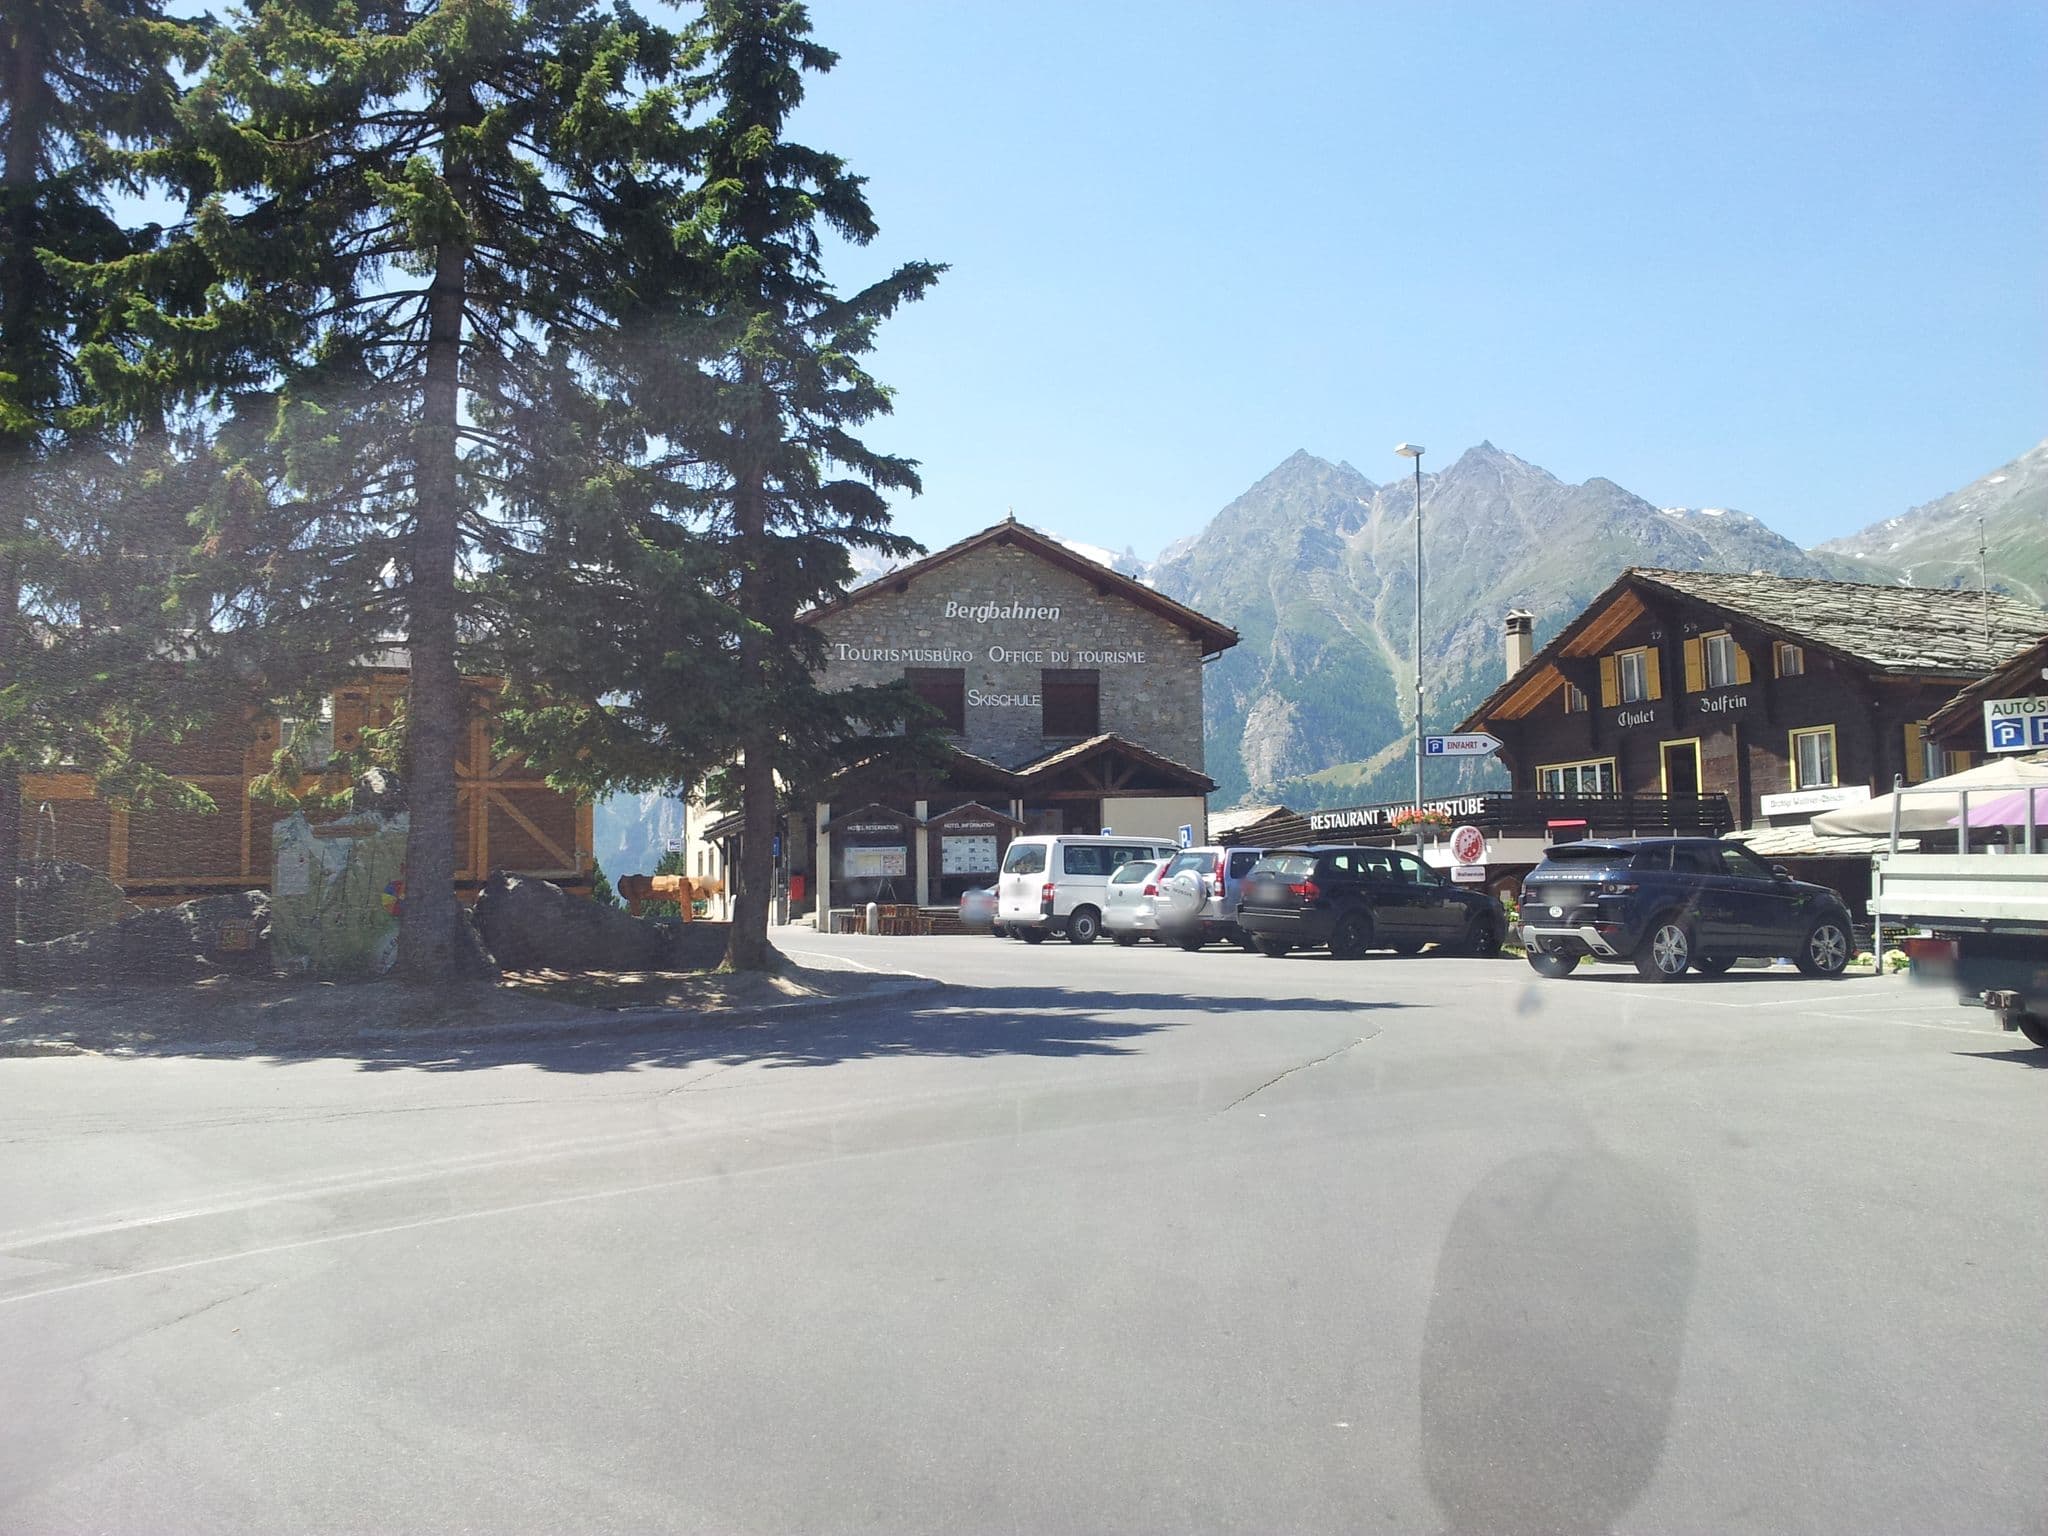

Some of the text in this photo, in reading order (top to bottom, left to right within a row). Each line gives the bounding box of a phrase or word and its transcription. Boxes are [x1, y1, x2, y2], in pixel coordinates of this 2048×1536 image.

[944, 601, 1061, 623] Bergbahnen
[835, 643, 1146, 664] TOURISMUSBÜRO OFFICE DU TOURISME
[967, 689, 1042, 708] SKISCHULE
[1700, 695, 1747, 713] Balfrin
[1992, 700, 2048, 716] AUTOS
[1617, 709, 1655, 728] Chalet
[2000, 727, 2015, 745] P
[1432, 741, 1478, 753] P EINFAHRT
[1310, 797, 1485, 830] RESTAURANT WSERSTUBE
